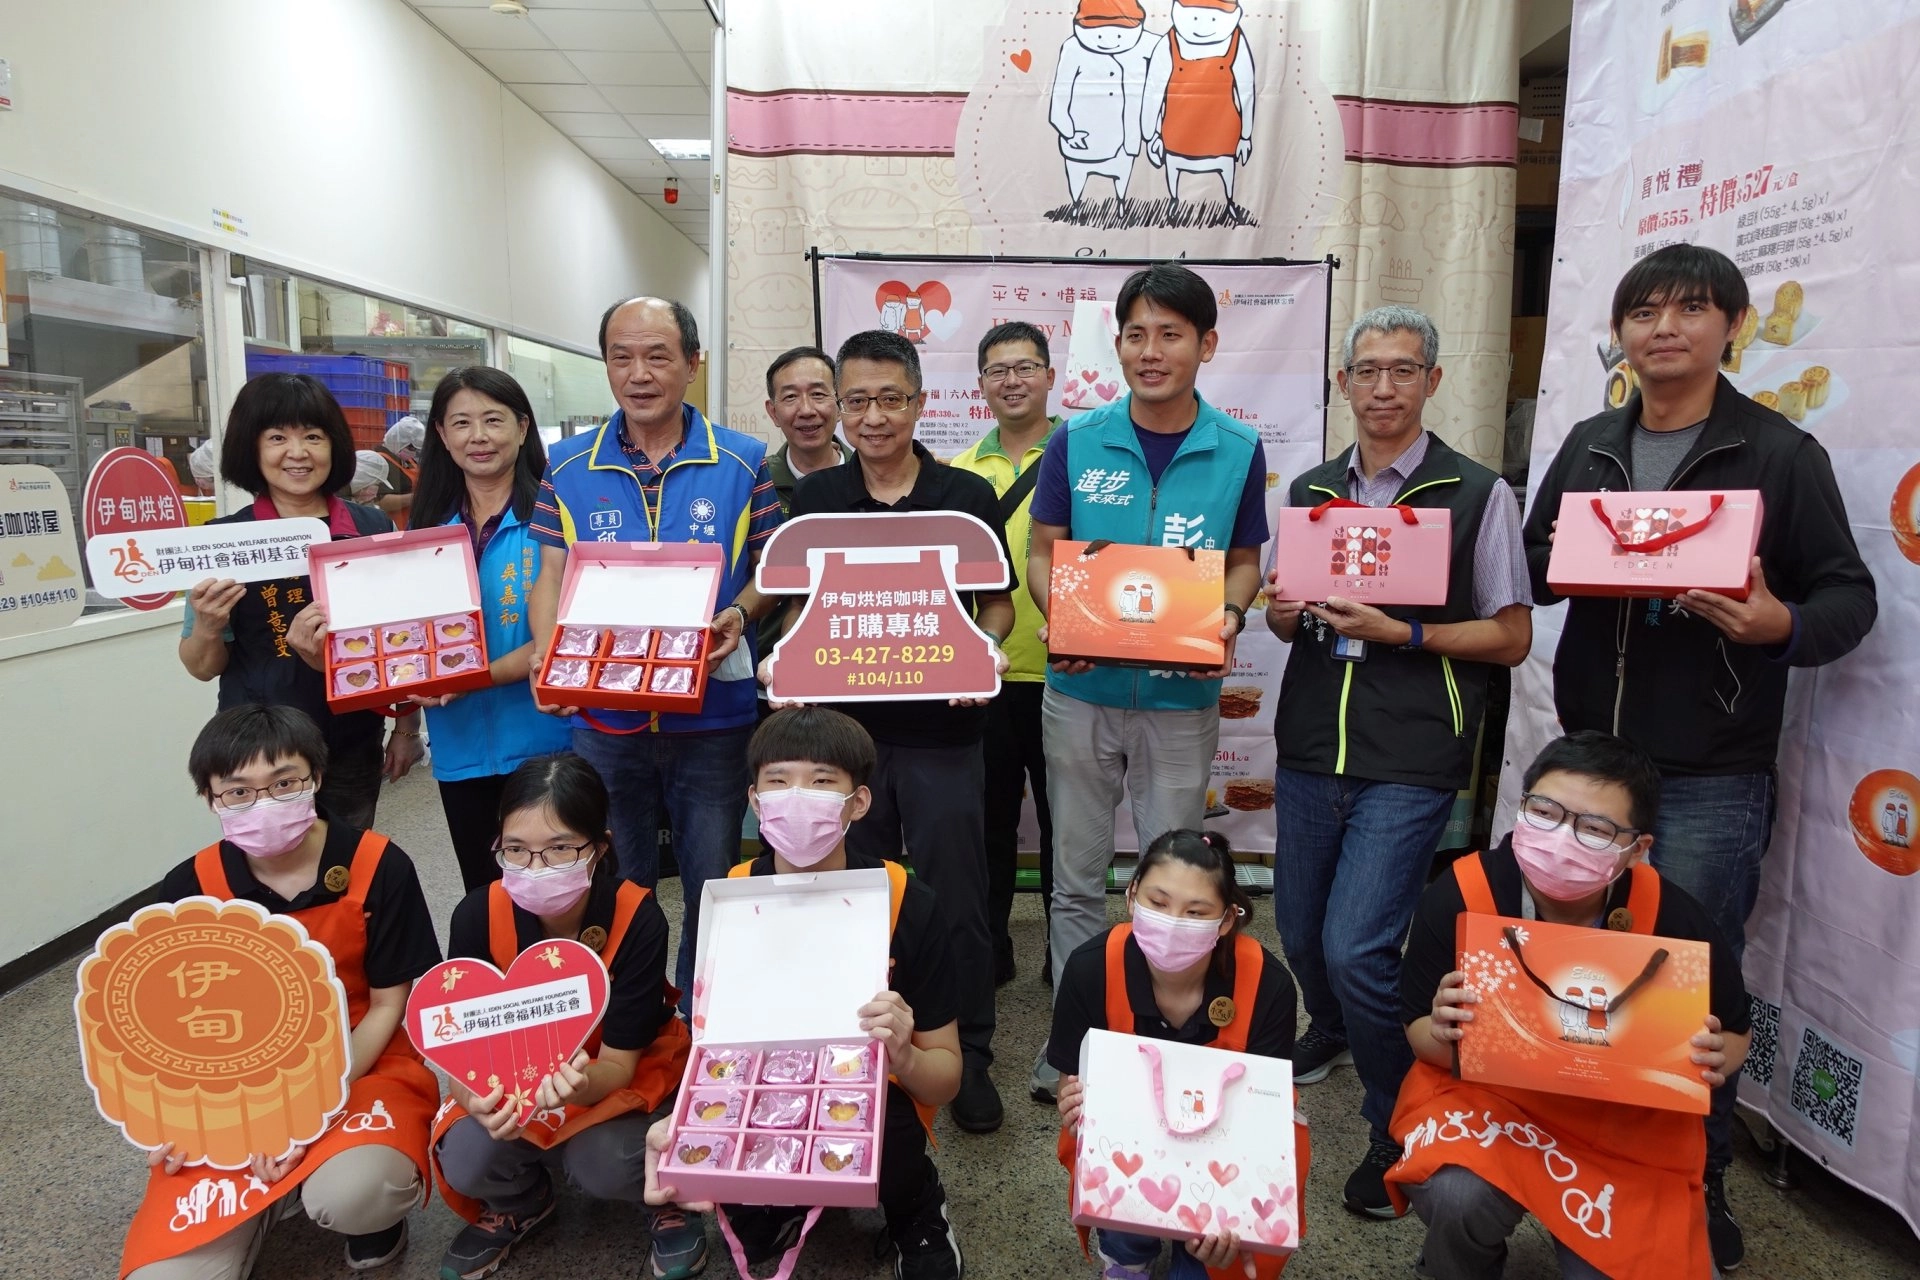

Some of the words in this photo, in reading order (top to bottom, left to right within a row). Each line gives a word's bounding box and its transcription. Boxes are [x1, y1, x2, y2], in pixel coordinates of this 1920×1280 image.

[1074, 468, 1131, 493] 進步
[1083, 493, 1134, 506] 未來式
[98, 495, 176, 526] 伊甸烘焙
[594, 513, 617, 527] 專員
[689, 523, 716, 536] 中壢
[156, 546, 191, 556] 財團法人
[192, 543, 211, 552] EDEN
[212, 541, 237, 550] SOCIAL
[238, 538, 268, 548] WELFARE
[269, 534, 312, 544] FOUNDATION
[21, 588, 77, 606] #104#110
[821, 589, 947, 608] 伊甸烘焙咖啡屋
[829, 612, 940, 640] 訂購專線
[814, 645, 955, 665] 03-427-8229
[847, 670, 924, 687] #104/110
[167, 960, 243, 1044] 伊甸
[502, 1002, 520, 1010] SOCIAL
[521, 997, 544, 1006] WELFARE
[545, 989, 578, 1000] FOUNDATION
[464, 996, 580, 1034] 伊甸社會福利基金會
